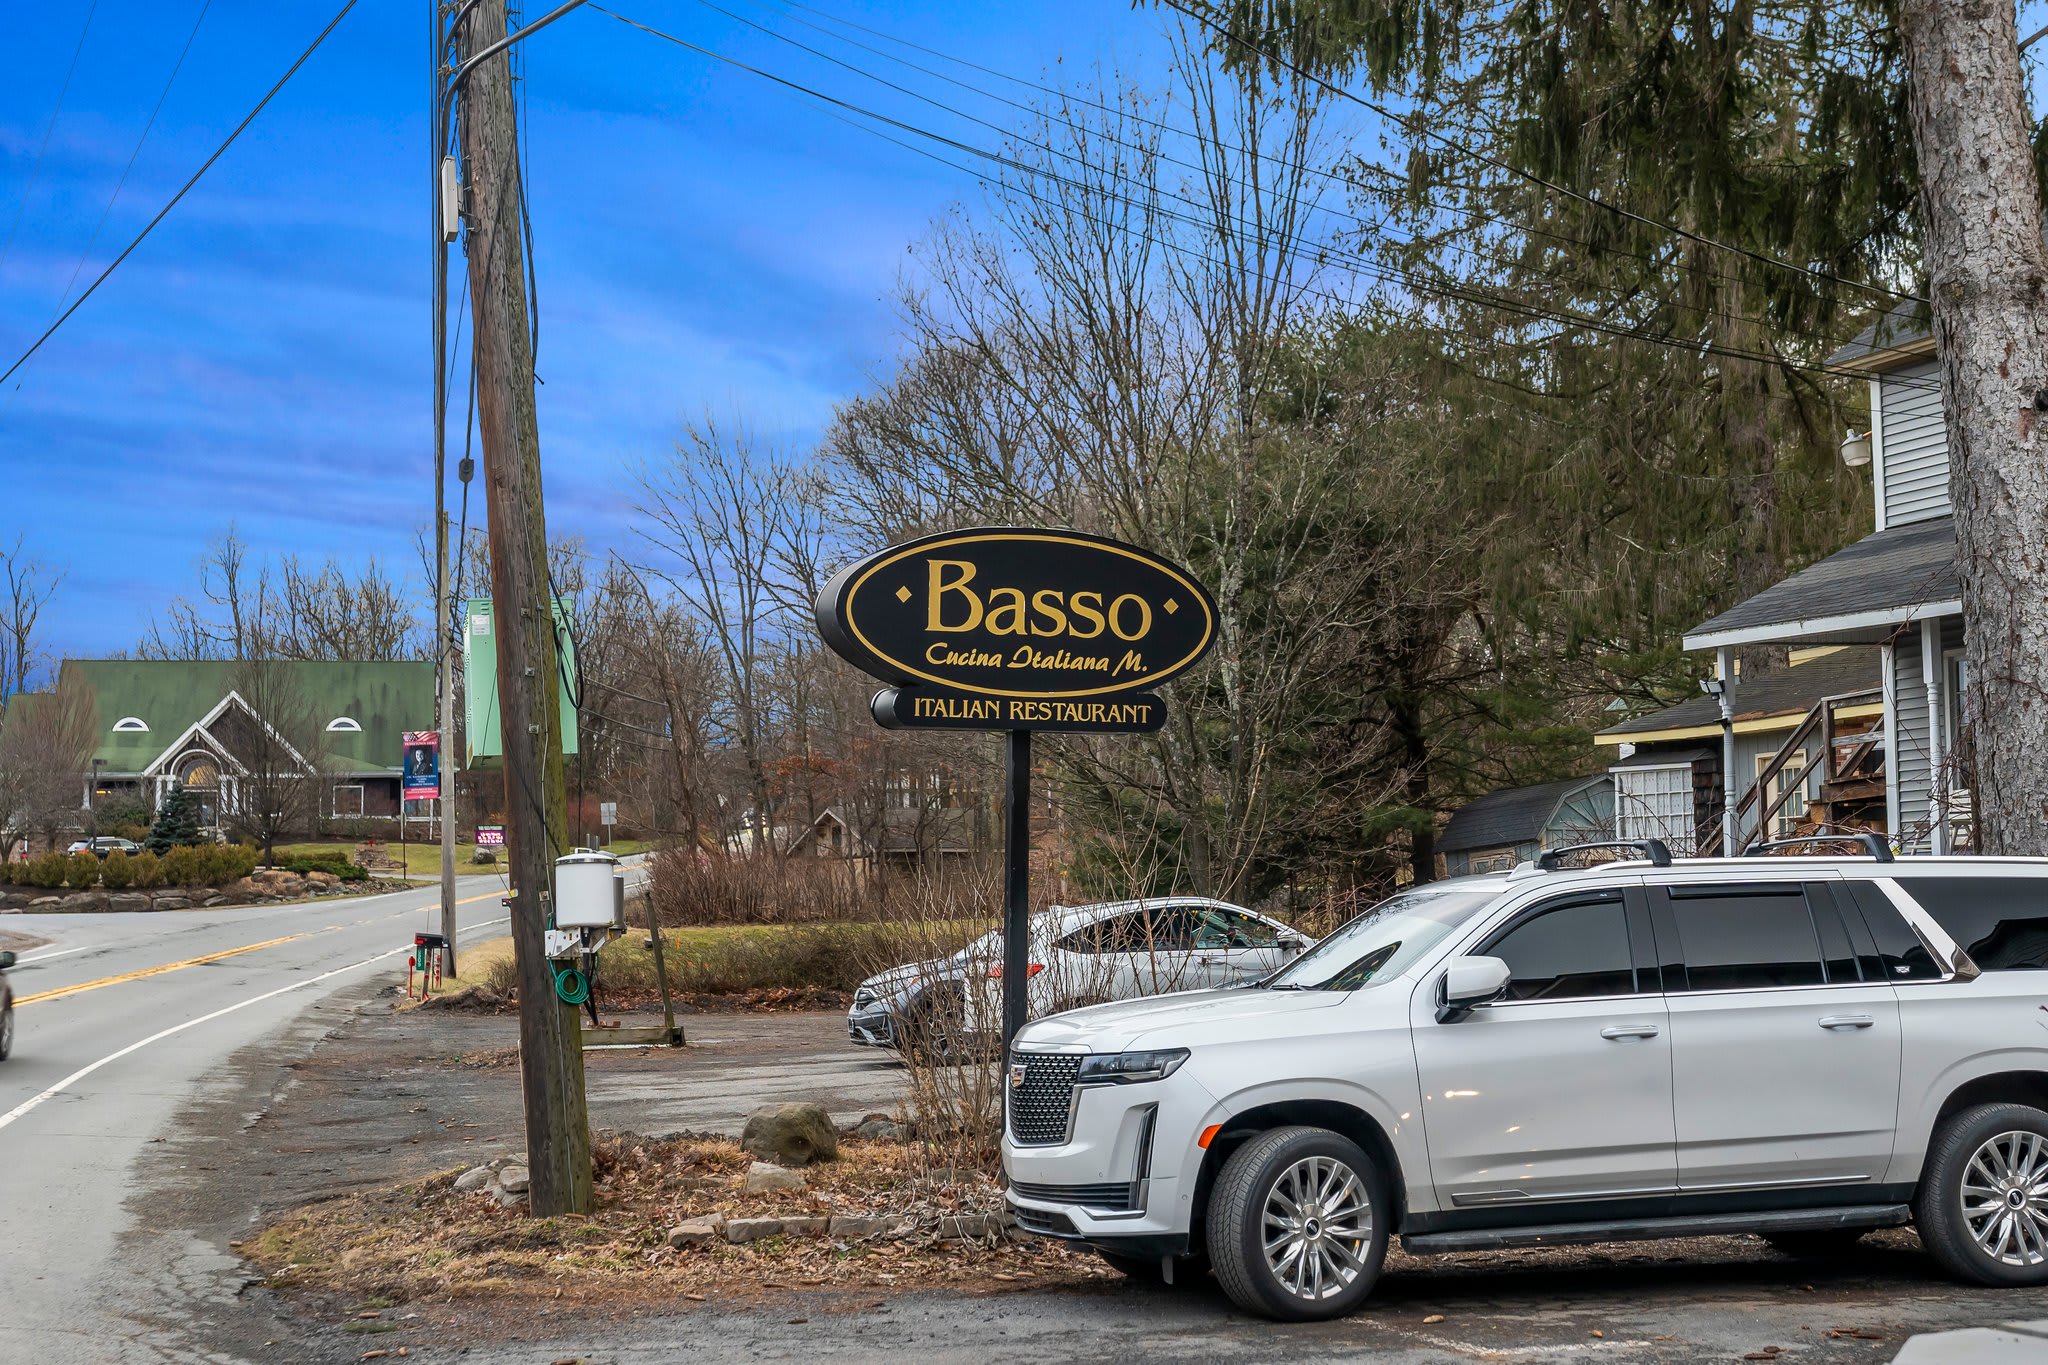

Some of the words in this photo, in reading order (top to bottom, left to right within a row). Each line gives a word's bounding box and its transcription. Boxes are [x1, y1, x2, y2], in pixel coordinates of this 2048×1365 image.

[924, 559, 1153, 641] Basso
[925, 642, 1002, 667] Cucina
[1007, 645, 1110, 671] Italiana
[1111, 649, 1148, 677] M.
[913, 697, 1000, 719] ITALIAN
[1009, 700, 1152, 724] RESTAURANT
